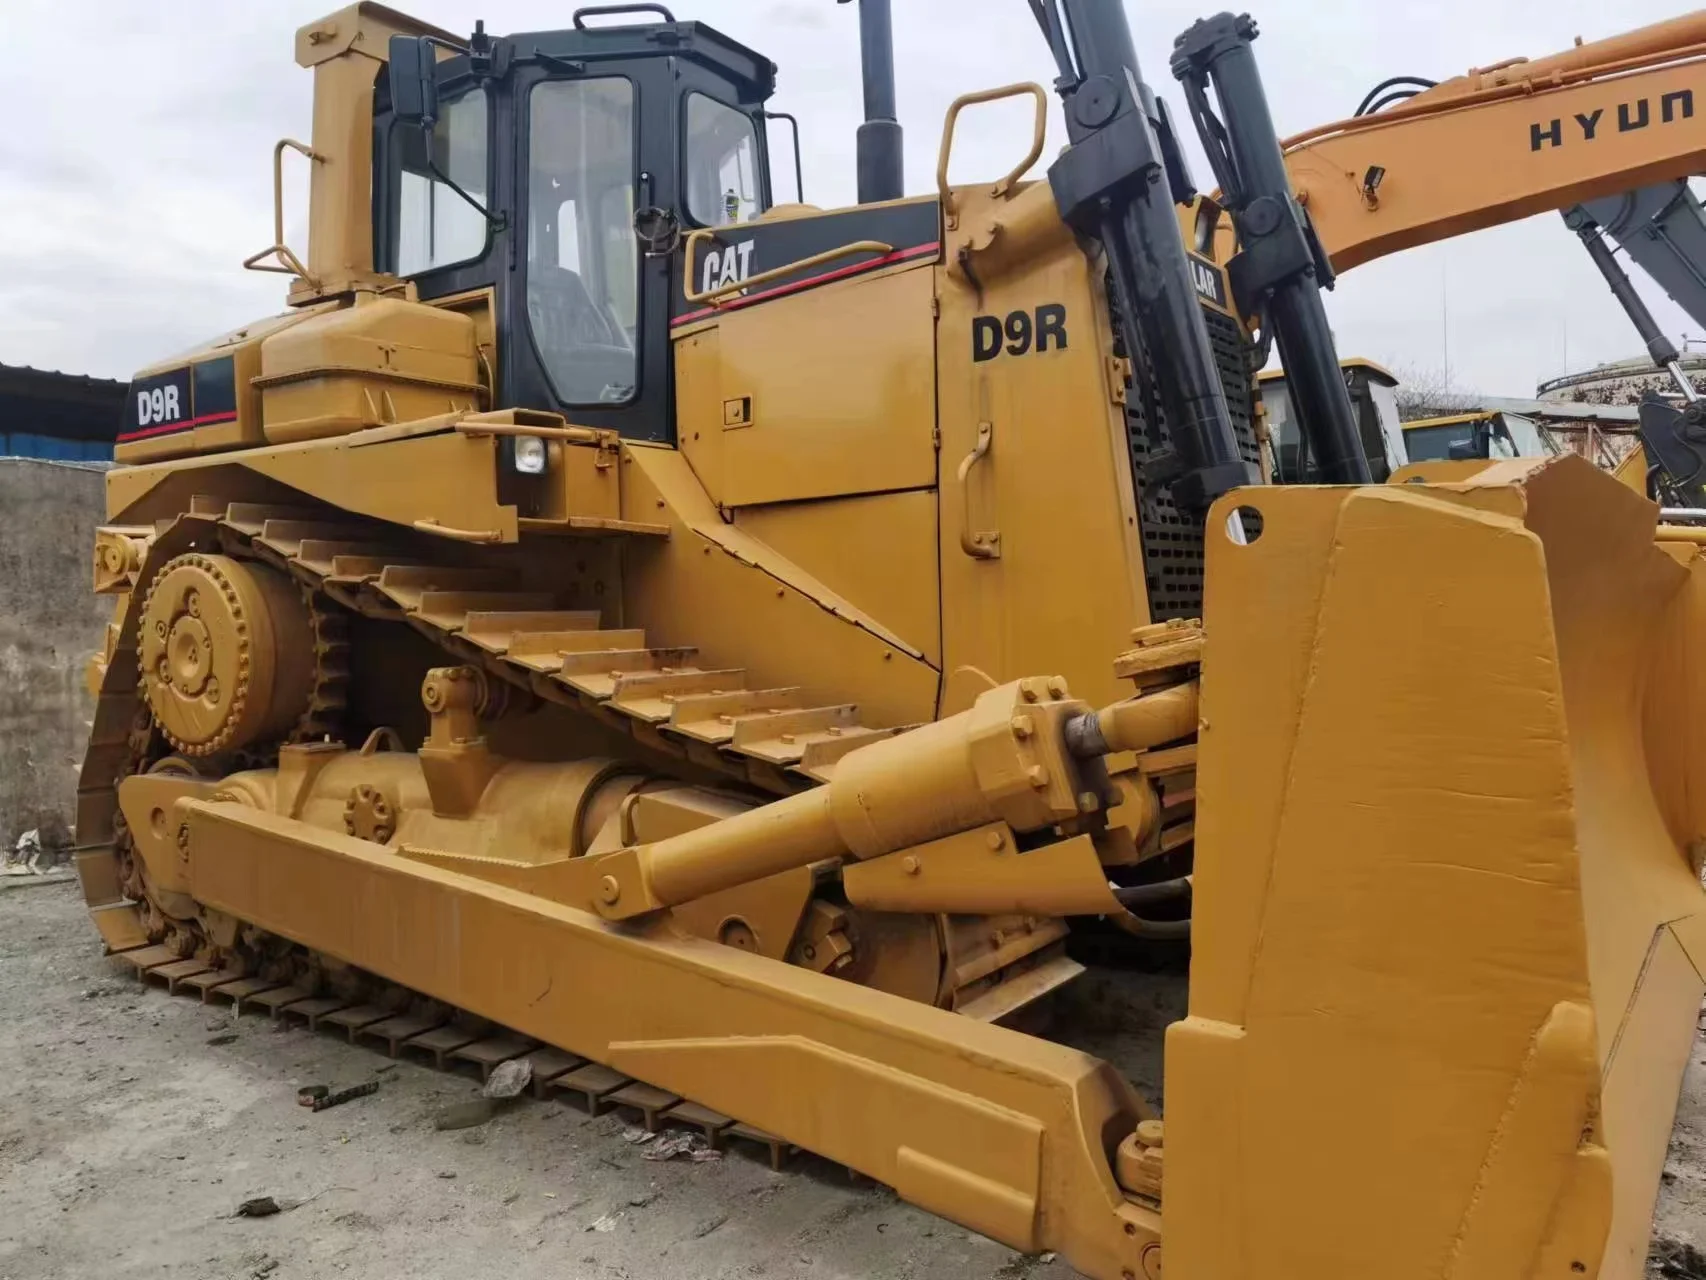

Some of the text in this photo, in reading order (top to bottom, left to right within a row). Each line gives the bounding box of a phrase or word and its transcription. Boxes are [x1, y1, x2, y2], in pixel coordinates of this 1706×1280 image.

[1530, 89, 1694, 152] HYUN
[702, 239, 755, 296] CAT
[972, 303, 1068, 363] D9R
[137, 384, 181, 426] D9R
